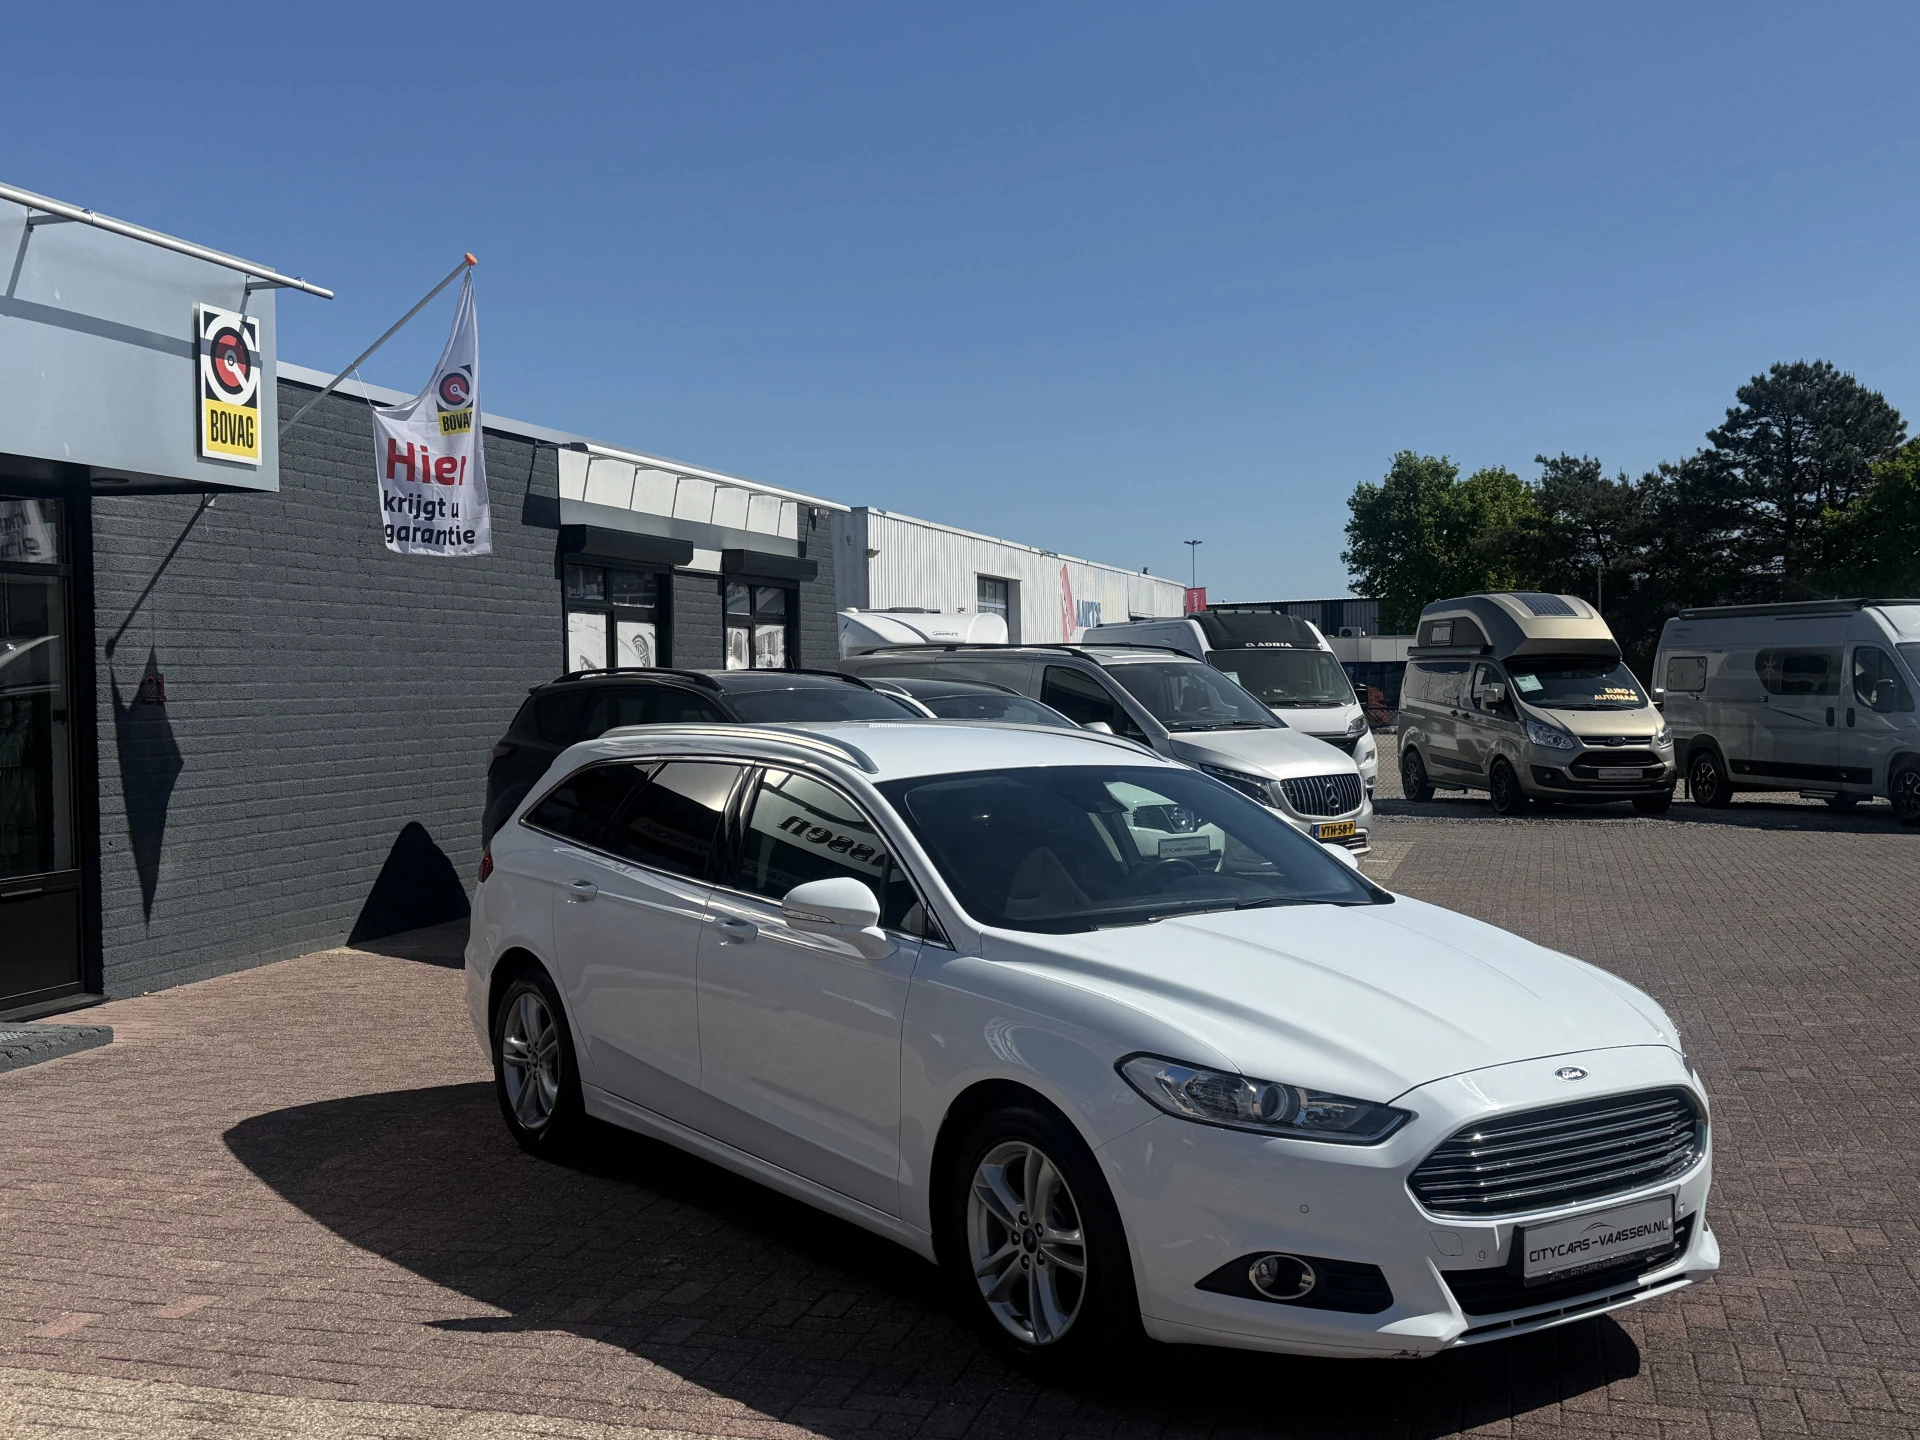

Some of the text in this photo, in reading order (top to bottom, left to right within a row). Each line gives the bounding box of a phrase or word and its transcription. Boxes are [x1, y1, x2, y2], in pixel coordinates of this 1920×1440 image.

[210, 409, 254, 449] BOVAG
[383, 489, 459, 521] krijgt u
[384, 523, 476, 546] garantie
[144, 674, 167, 702] 21
[1604, 687, 1629, 695] EURO
[1321, 823, 1354, 837] VTH-58-P
[1529, 1220, 1669, 1263] CITYCARS-VAASSEN.NL
